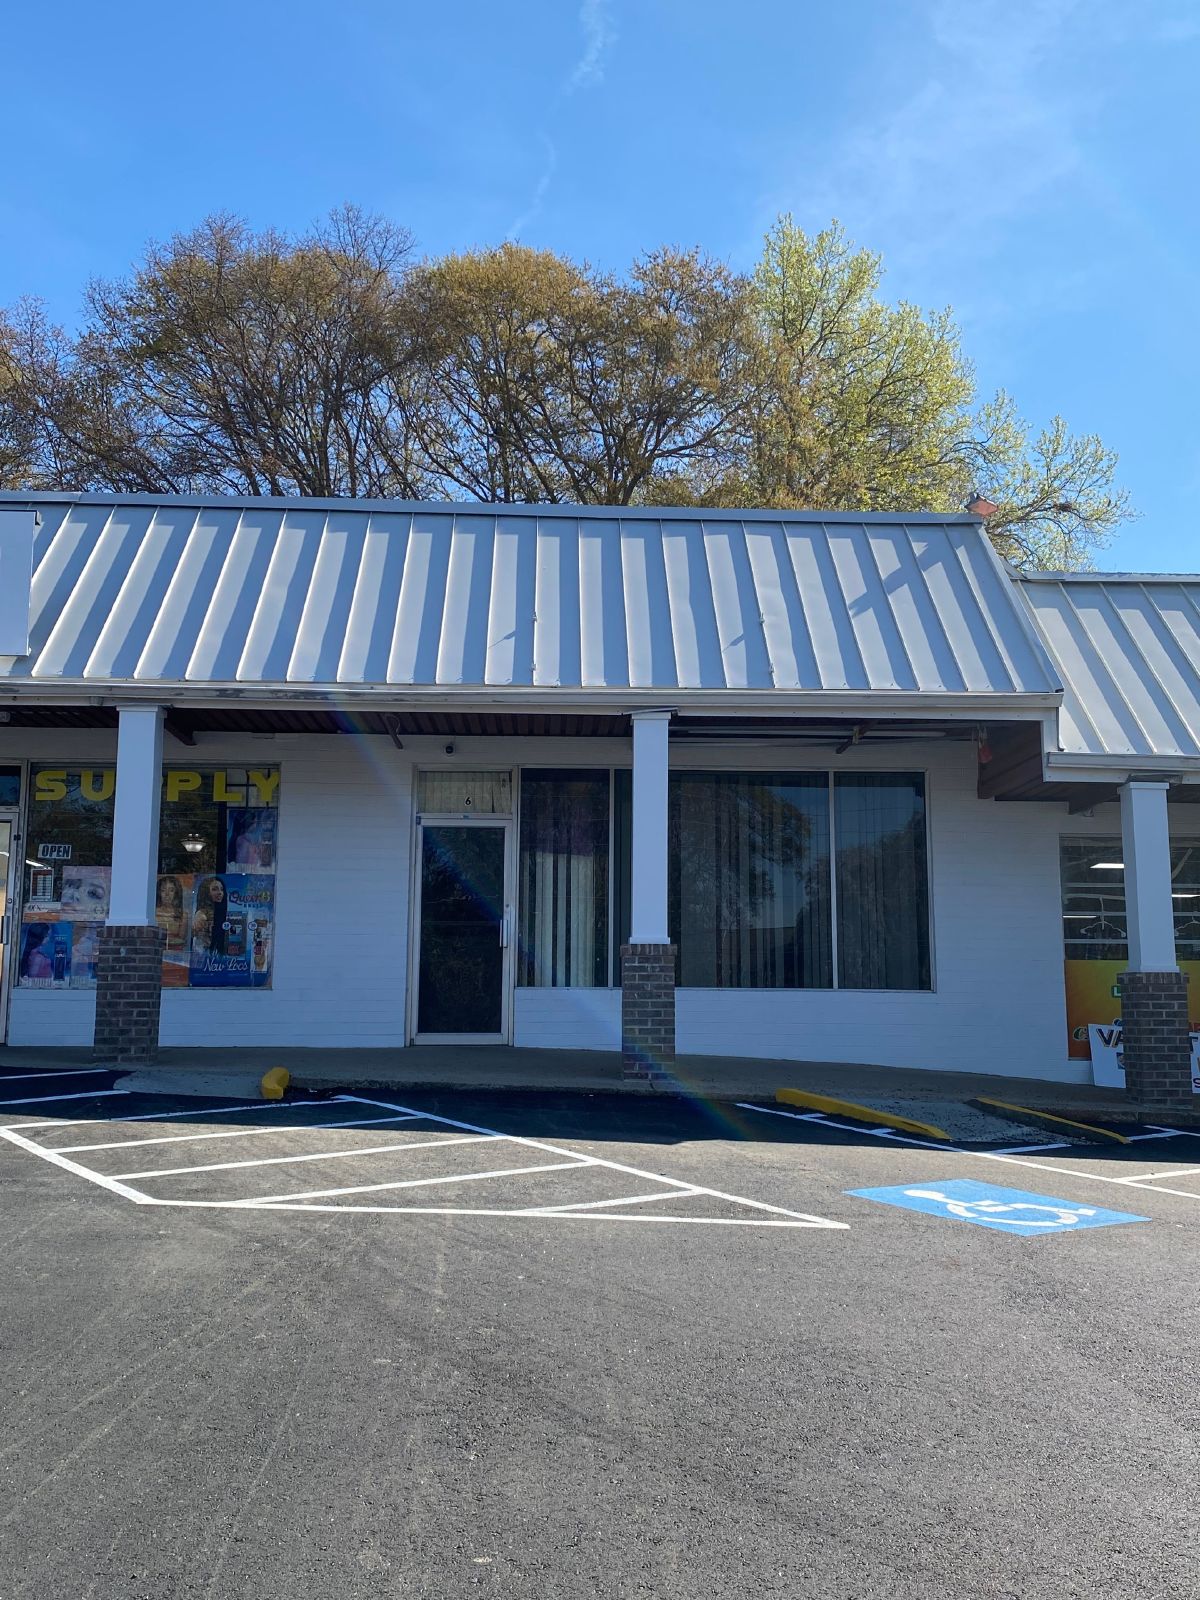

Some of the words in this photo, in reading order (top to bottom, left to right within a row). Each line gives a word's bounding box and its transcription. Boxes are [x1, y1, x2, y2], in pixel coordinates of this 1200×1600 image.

[36, 770, 279, 802] SUPLY
[465, 796, 472, 806] 6
[41, 844, 71, 858] OPEN
[203, 957, 225, 972] New
[226, 957, 249, 972] Locs
